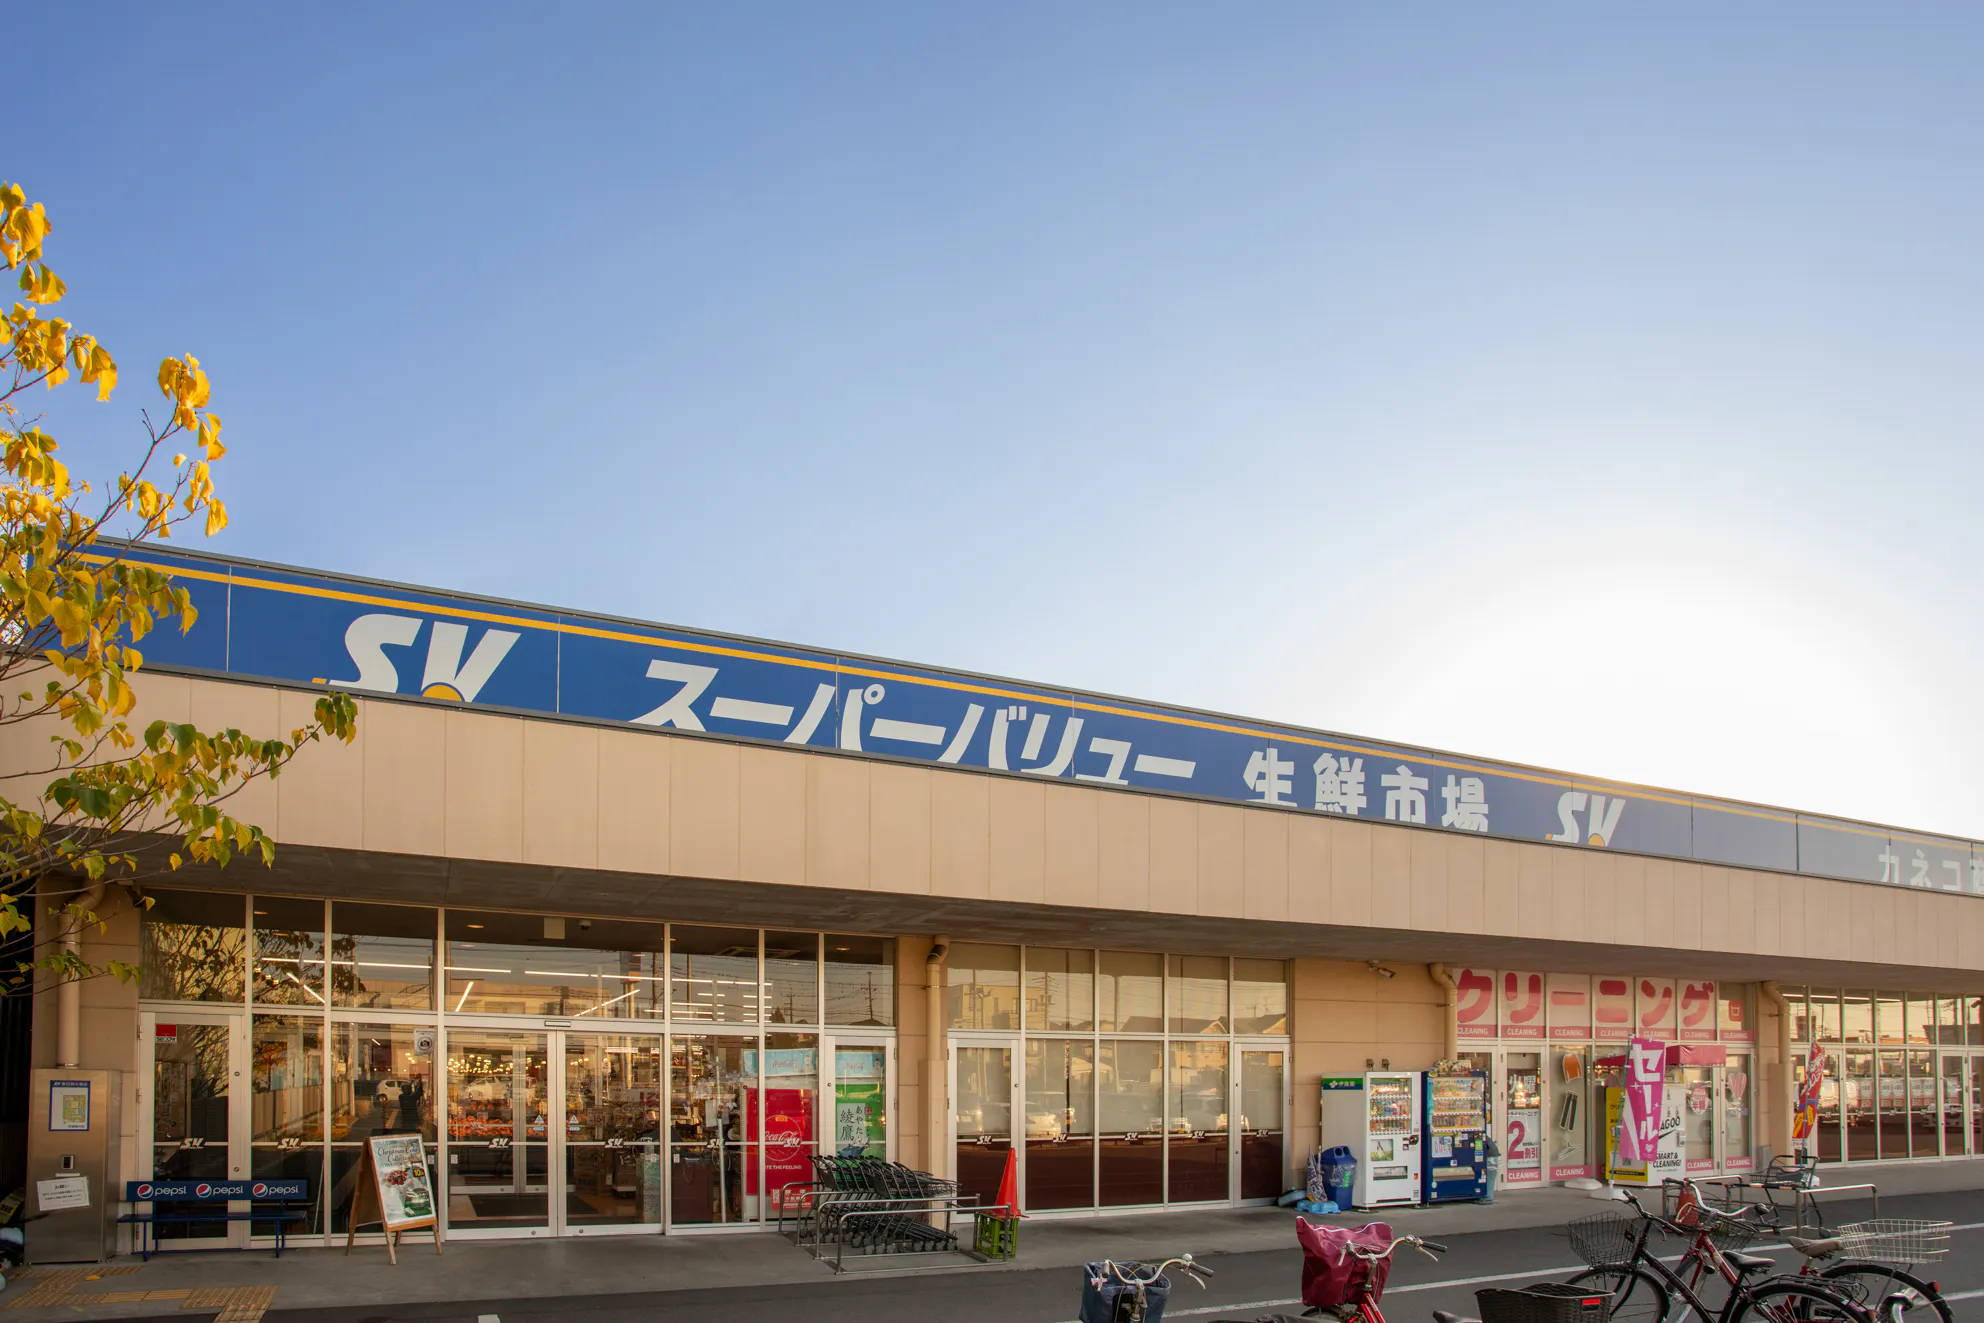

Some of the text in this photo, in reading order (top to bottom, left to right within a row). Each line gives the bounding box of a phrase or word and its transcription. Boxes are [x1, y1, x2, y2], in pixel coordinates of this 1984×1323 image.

[328, 614, 521, 702] SV
[629, 659, 1488, 832] スーパーバリュー 生鮮市場
[1550, 792, 1625, 847] SV
[1457, 968, 1714, 1028] クリーニング
[1457, 1027, 1489, 1035] CLEANING
[1507, 1028, 1538, 1036] CLEANING
[1555, 1029, 1584, 1037] CLEANING
[1600, 1029, 1628, 1037] CLEANING
[1644, 1030, 1670, 1038] CLEANING
[1685, 1031, 1710, 1039] CLEANING
[1629, 1043, 1663, 1141] セール
[1659, 1116, 1681, 1131] AGOO
[1687, 1160, 1712, 1168] CLEANING
[1508, 1171, 1539, 1179] CLEANING
[1556, 1168, 1585, 1176] CLEANING
[154, 1184, 299, 1196] pepsi pepsi pepsi
